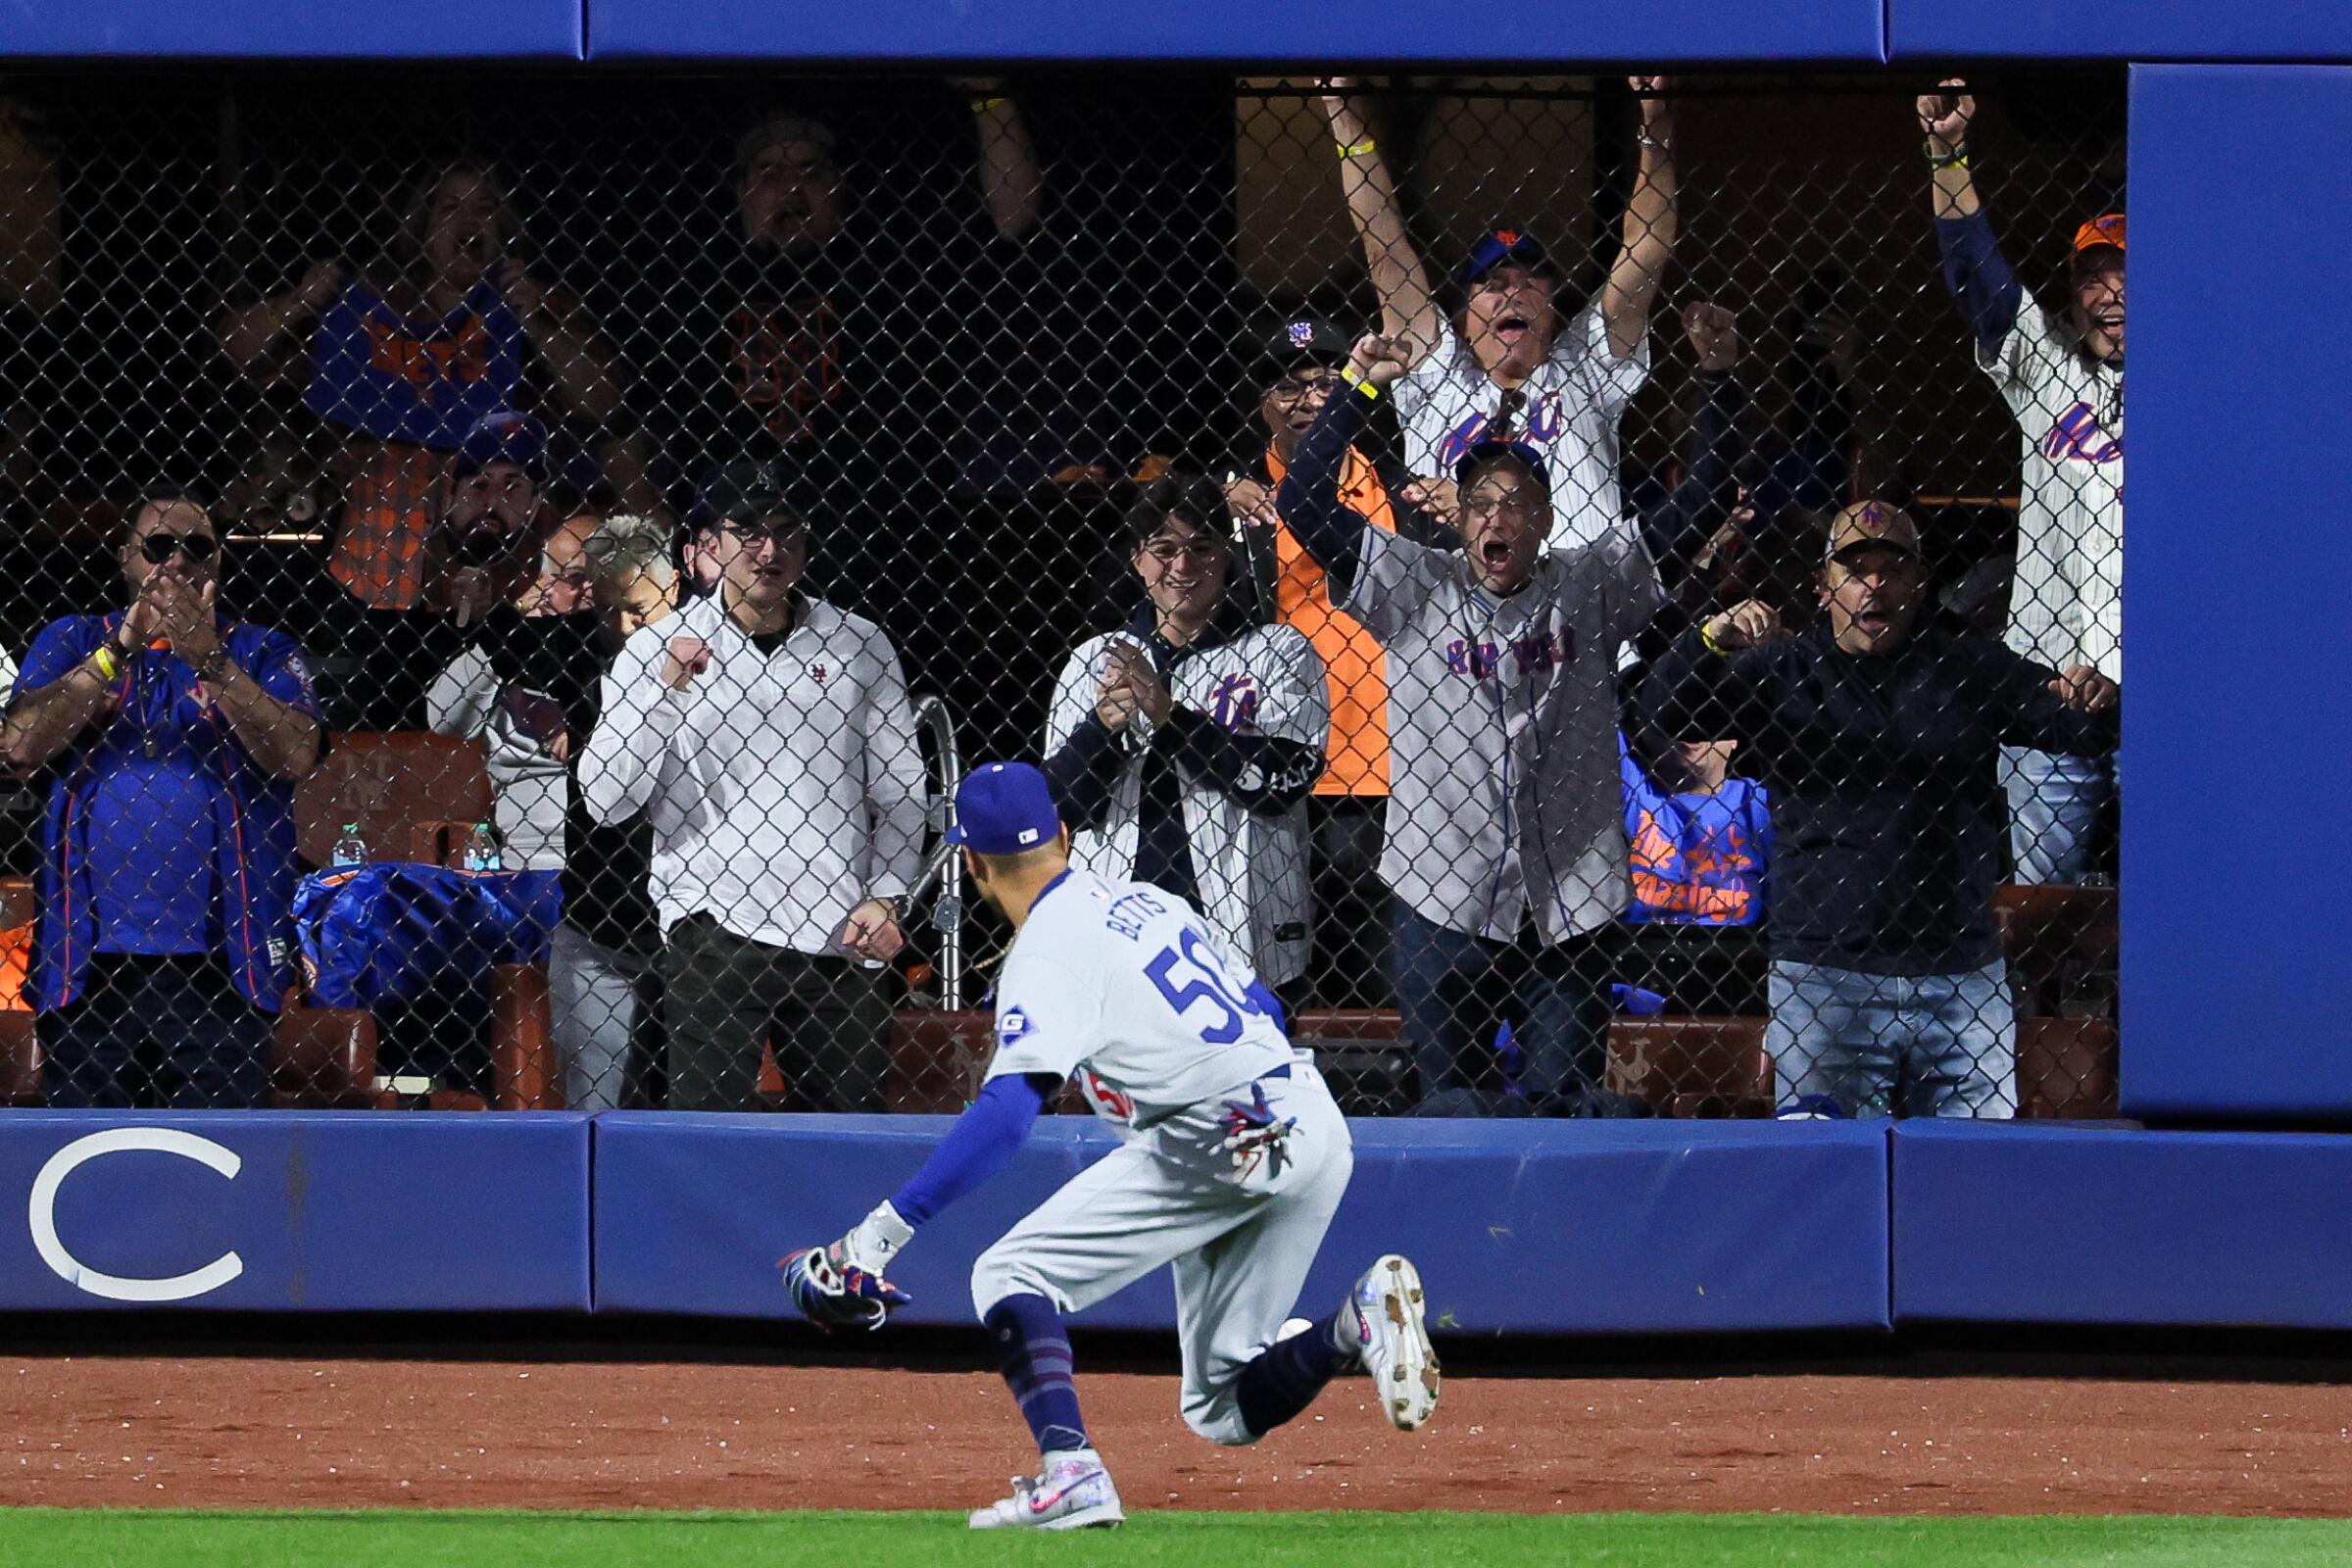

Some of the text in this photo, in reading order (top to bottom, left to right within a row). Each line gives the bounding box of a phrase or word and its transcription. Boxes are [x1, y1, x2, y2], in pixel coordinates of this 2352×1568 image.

[1106, 892, 1167, 943] BETTS
[1142, 925, 1262, 1045] 50
[28, 1127, 244, 1301] C
